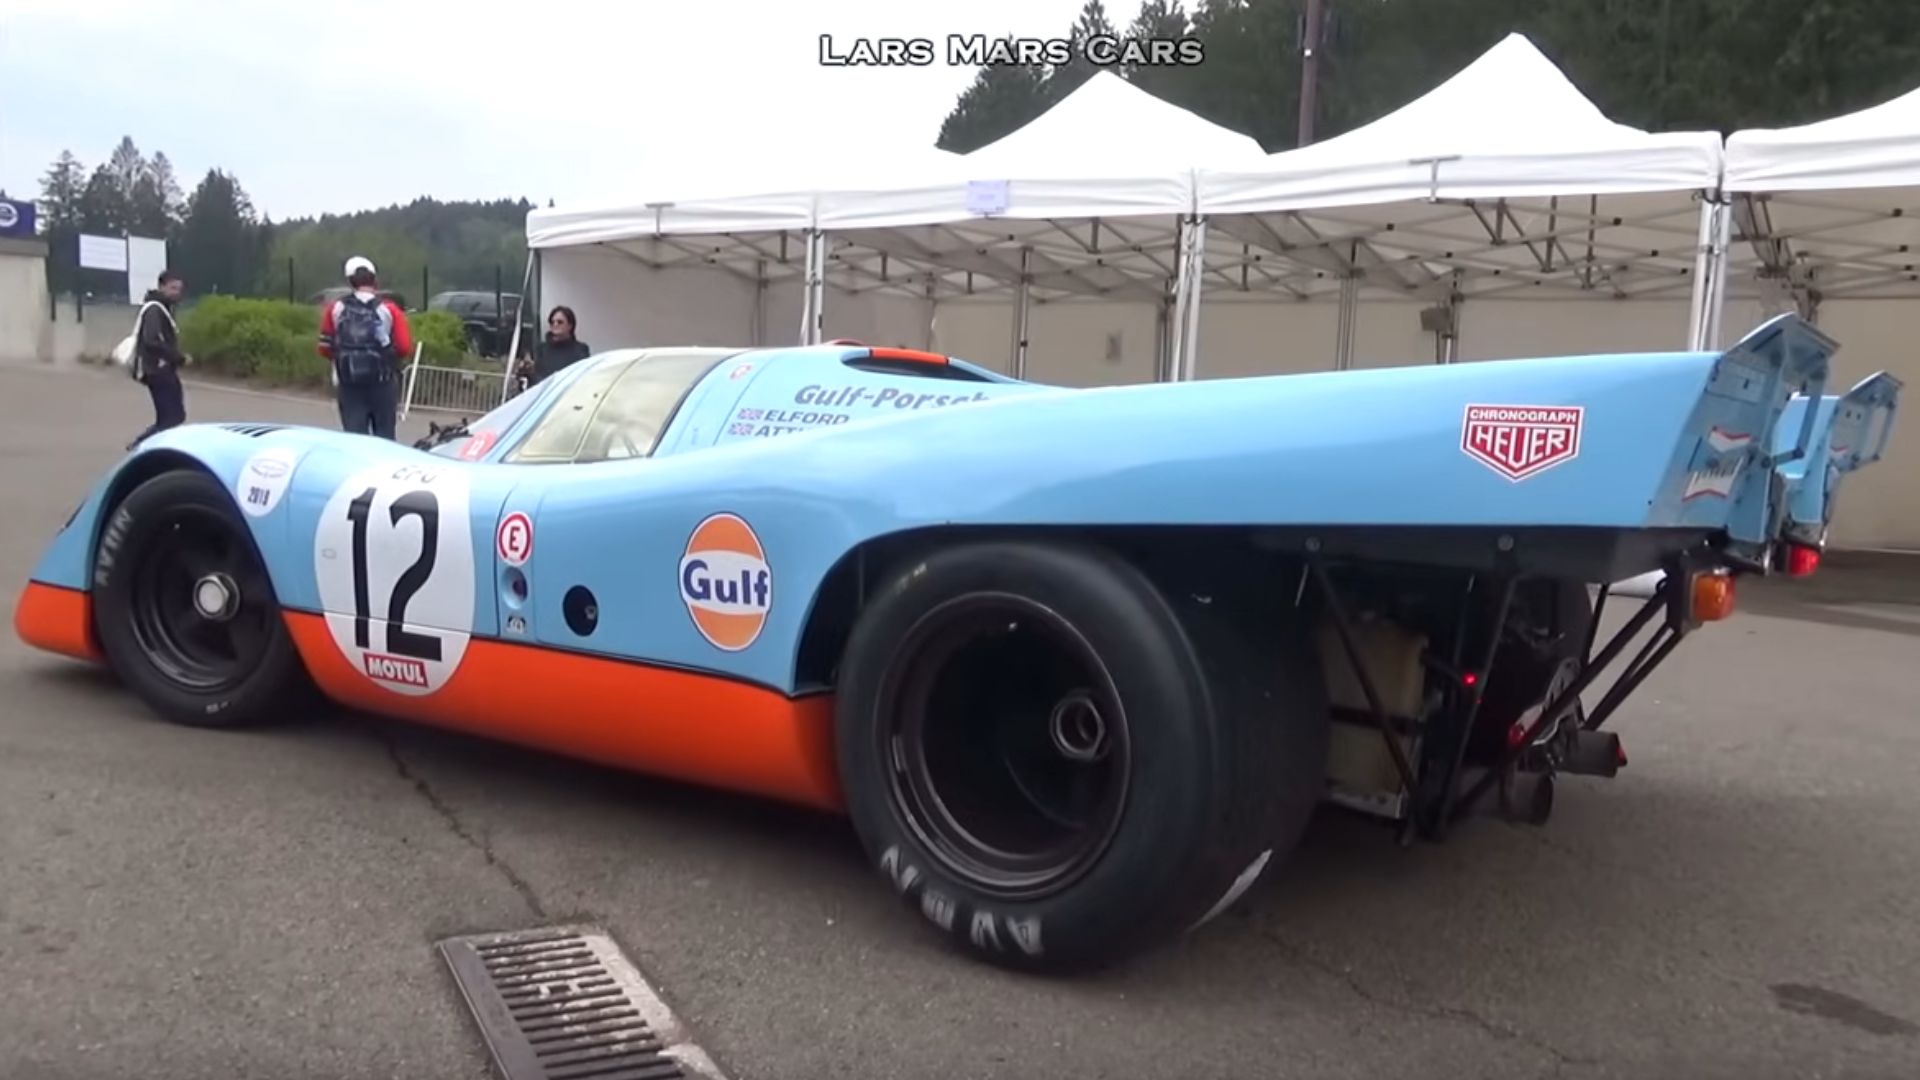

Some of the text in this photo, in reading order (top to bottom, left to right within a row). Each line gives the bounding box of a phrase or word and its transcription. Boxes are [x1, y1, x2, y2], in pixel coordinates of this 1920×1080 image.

[764, 409, 850, 425] ELFORD
[1469, 409, 1576, 422] CHRONOGRAPH
[1475, 426, 1566, 468] HEUER
[508, 526, 521, 551] E
[346, 487, 442, 661] 12
[683, 559, 768, 607] Gulf
[368, 657, 424, 683] MOTUL
